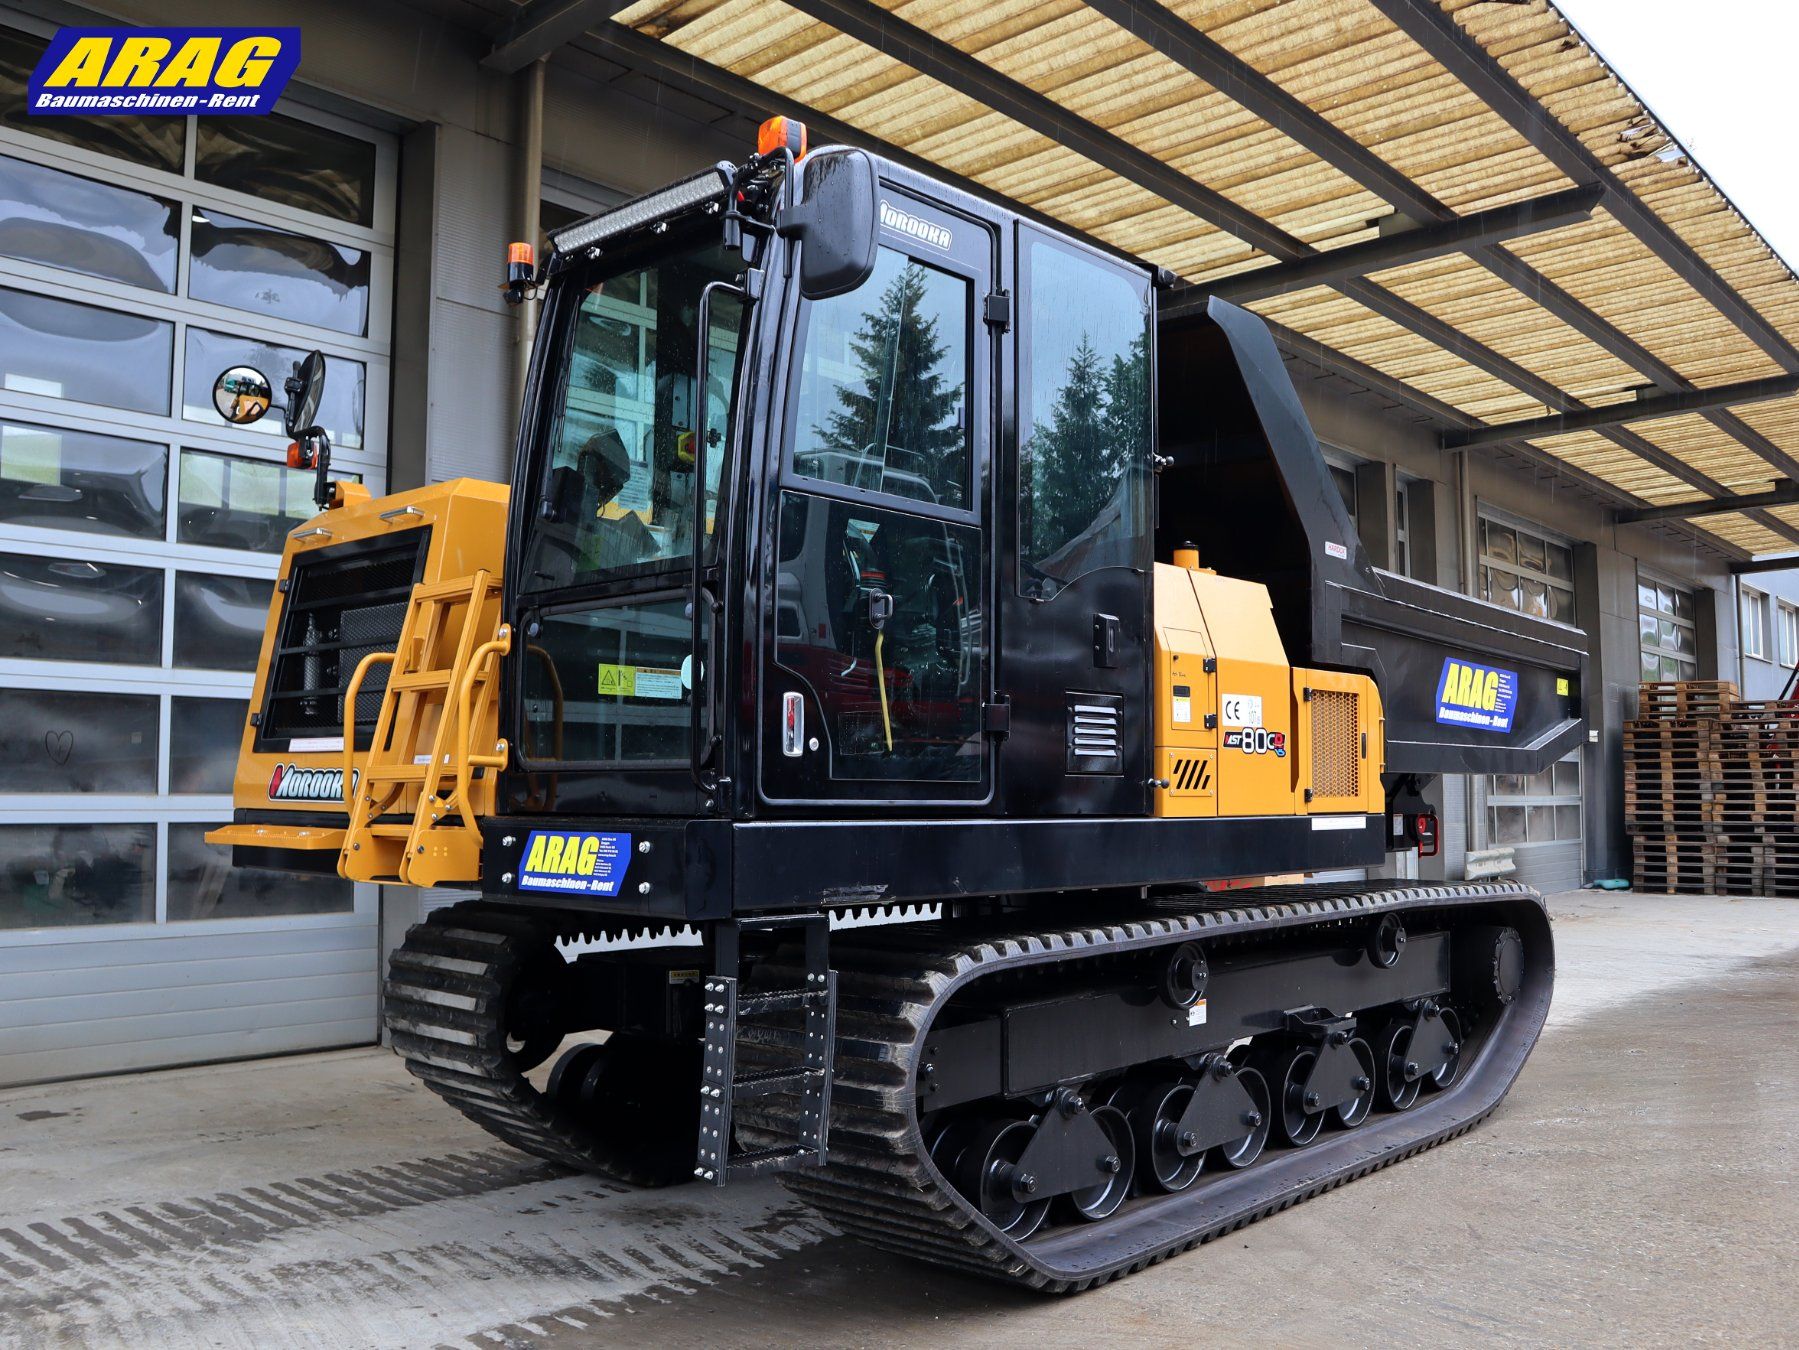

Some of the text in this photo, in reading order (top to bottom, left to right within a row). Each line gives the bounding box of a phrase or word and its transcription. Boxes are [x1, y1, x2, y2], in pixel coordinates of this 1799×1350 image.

[1441, 663, 1499, 711] ARAG
[269, 764, 357, 799] MOROOK
[525, 835, 600, 876] ARAG
